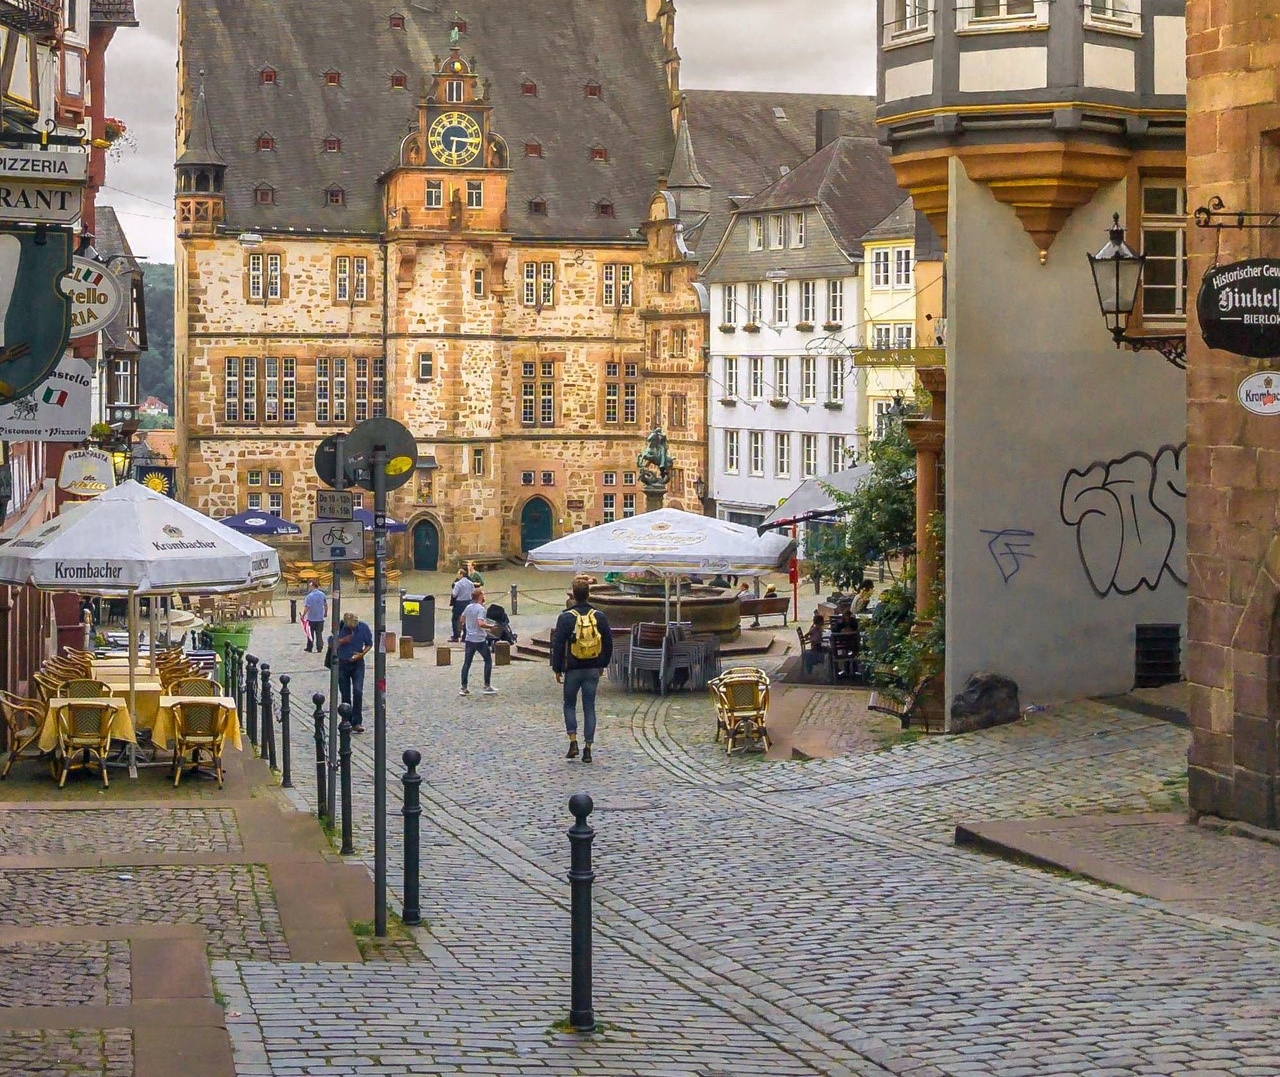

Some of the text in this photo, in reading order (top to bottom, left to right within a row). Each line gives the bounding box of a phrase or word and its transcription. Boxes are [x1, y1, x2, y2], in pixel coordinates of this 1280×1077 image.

[1212, 265, 1262, 290] Historischer
[48, 371, 90, 387] astello
[49, 426, 87, 437] Pizzeria
[68, 451, 86, 461] PIZZA
[90, 451, 108, 463] PASTA
[152, 539, 217, 551] Krombacher
[54, 561, 122, 579] Krombacher
